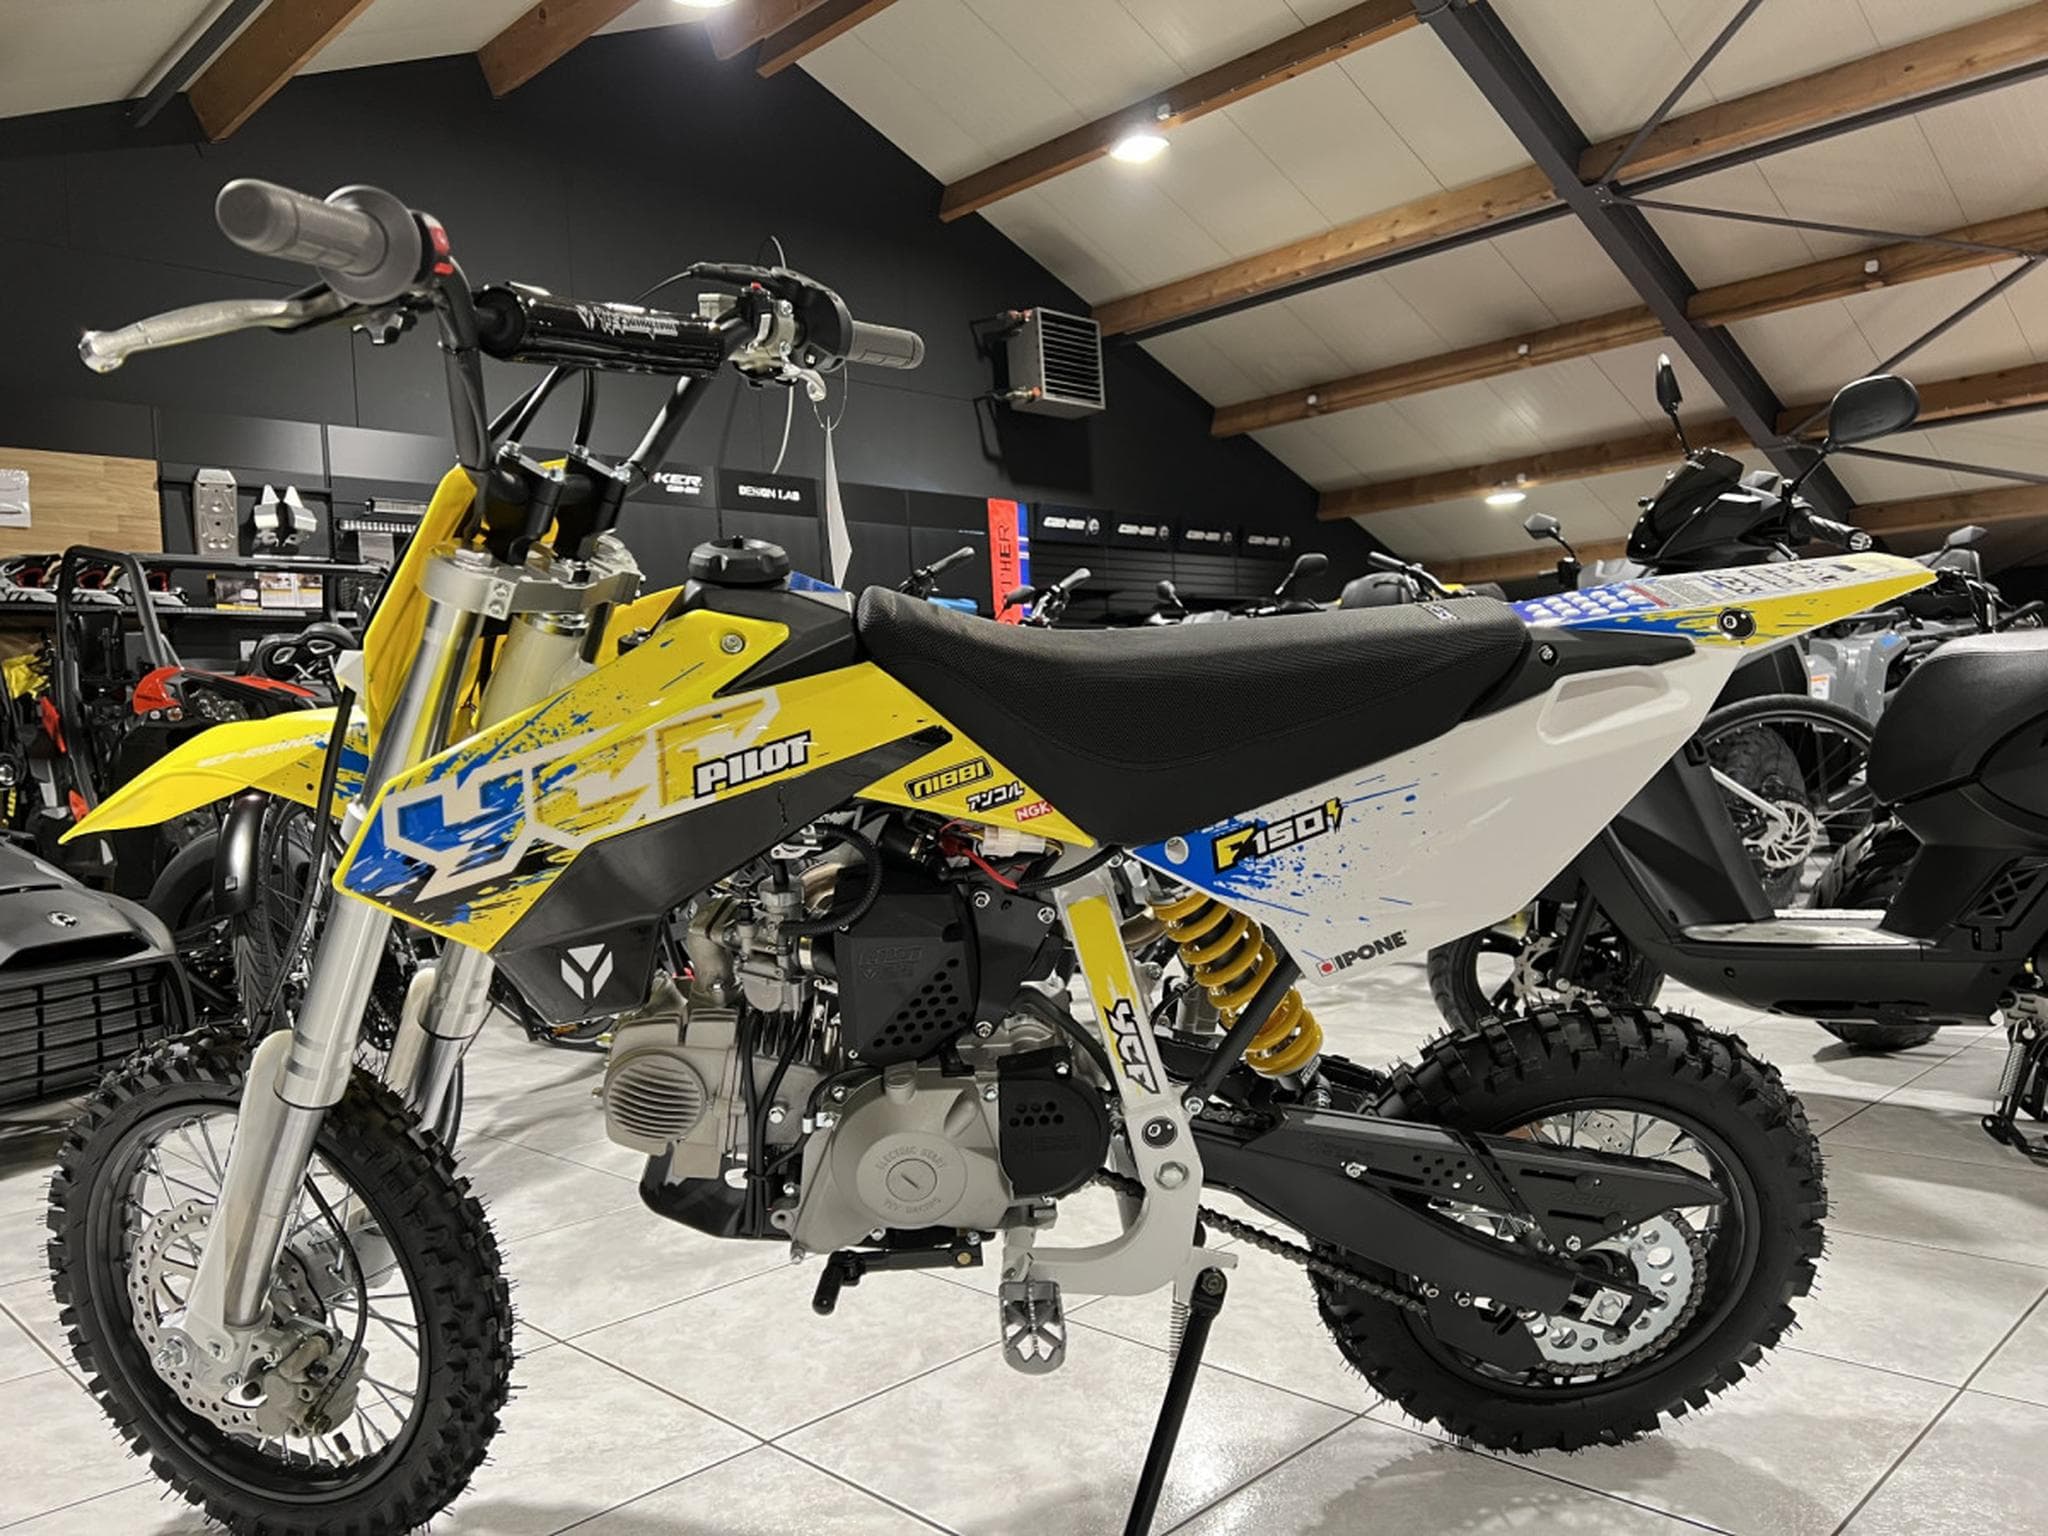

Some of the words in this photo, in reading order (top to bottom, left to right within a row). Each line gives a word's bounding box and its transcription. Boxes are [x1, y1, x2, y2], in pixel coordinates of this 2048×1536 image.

[778, 489, 800, 501] LAB
[694, 731, 810, 797] PILOT
[1016, 801, 1051, 821] NGK
[1335, 930, 1407, 969] IPONE
